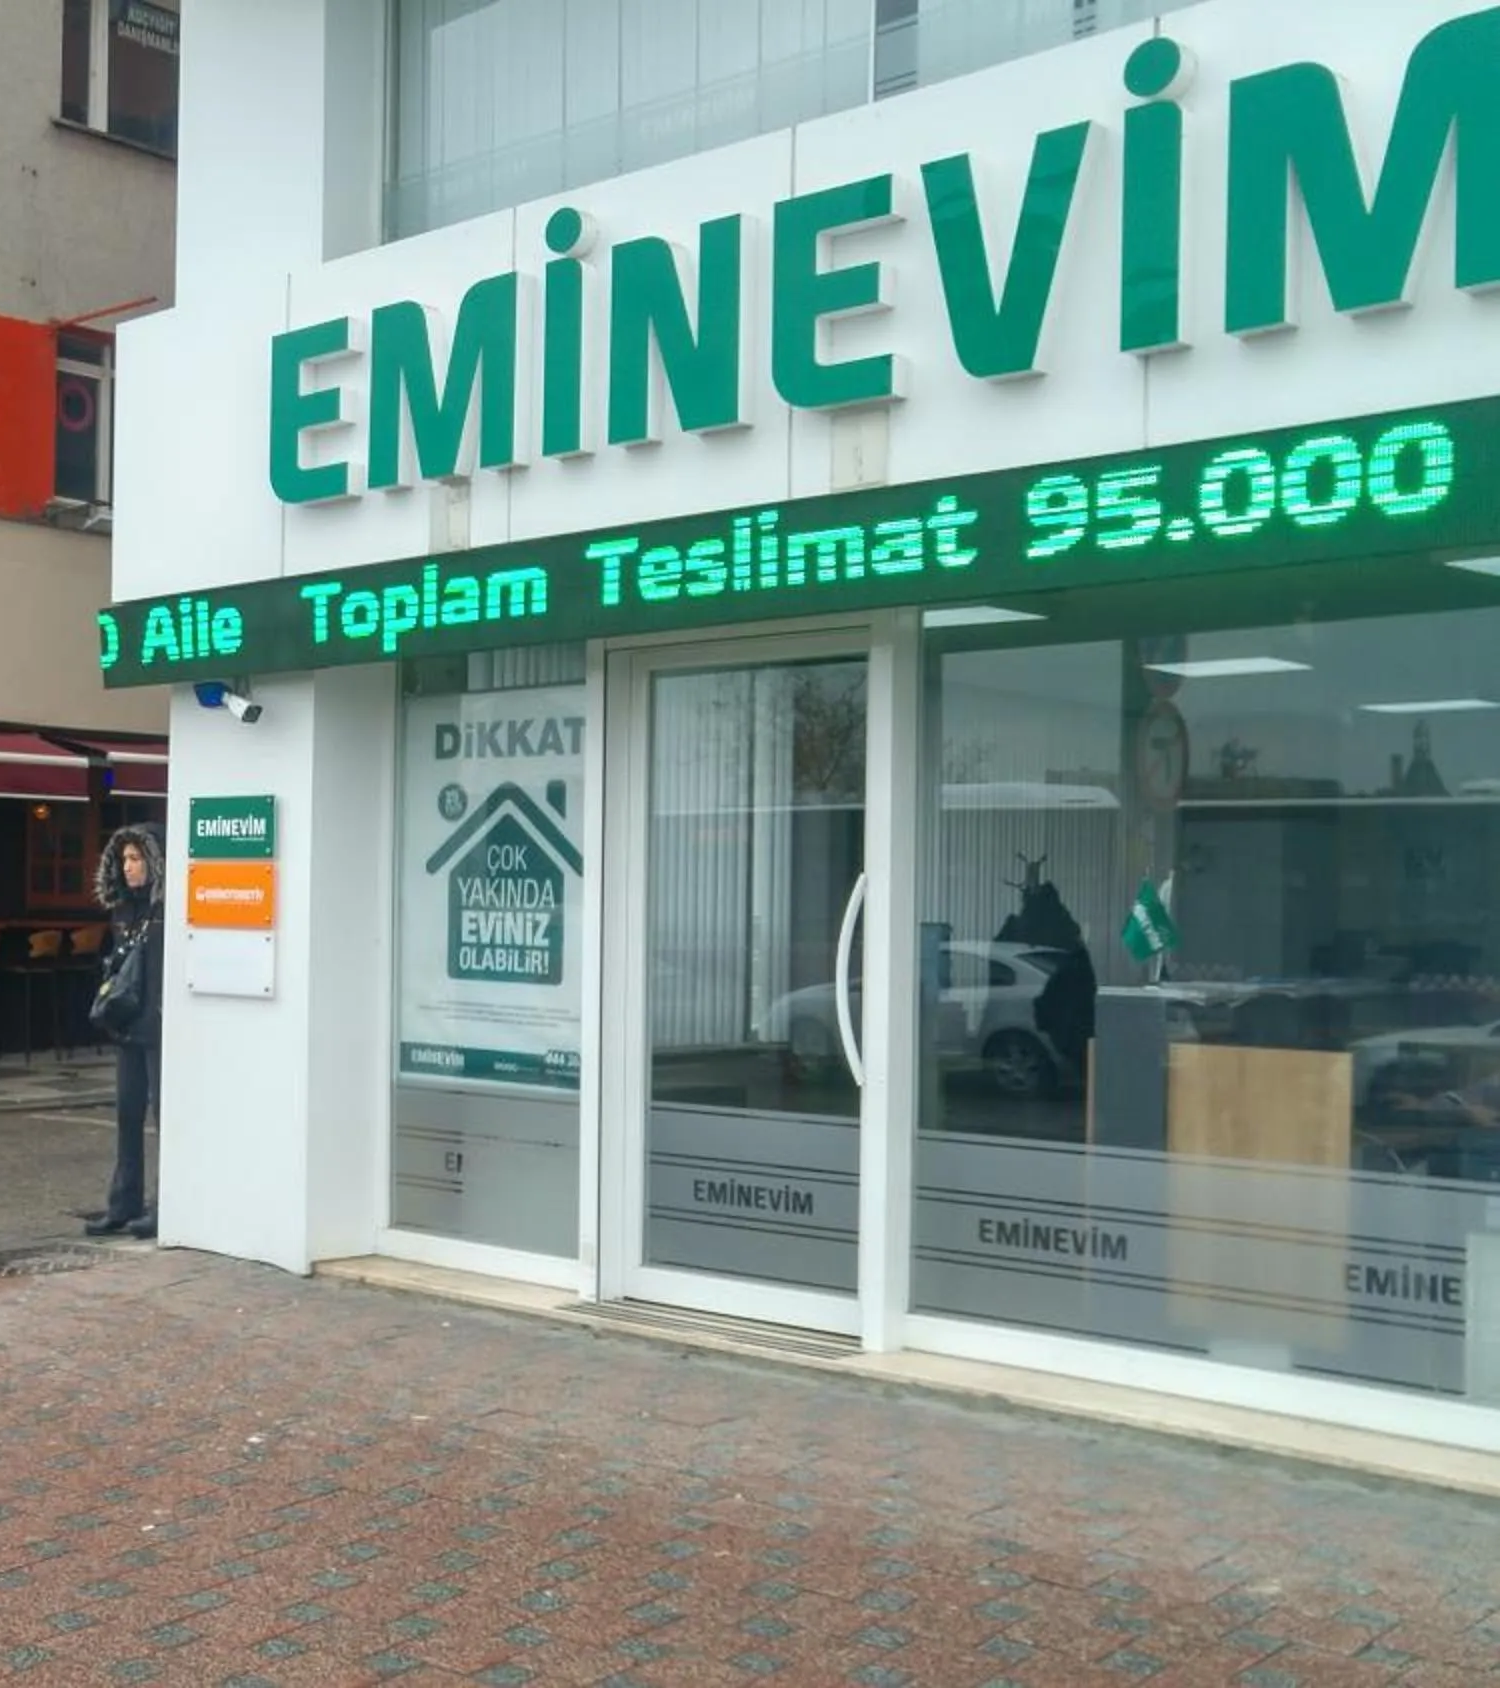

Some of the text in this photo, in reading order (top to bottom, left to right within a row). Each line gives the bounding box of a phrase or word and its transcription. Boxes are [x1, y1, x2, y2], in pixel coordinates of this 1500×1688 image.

[270, 5, 1500, 504] EMİNEVİM
[141, 597, 243, 665] Aile
[301, 564, 548, 653] Toplam
[586, 496, 978, 606] Teslimat
[1026, 421, 1454, 560] 95.000
[196, 813, 266, 837] EMİNEVİM
[486, 844, 528, 876] ÇOK
[457, 876, 556, 909] YAKINDA
[693, 1178, 814, 1215] EMİNEVİM
[978, 1217, 1128, 1261] EMİNEVİM
[1344, 1263, 1463, 1306] EMİNE
